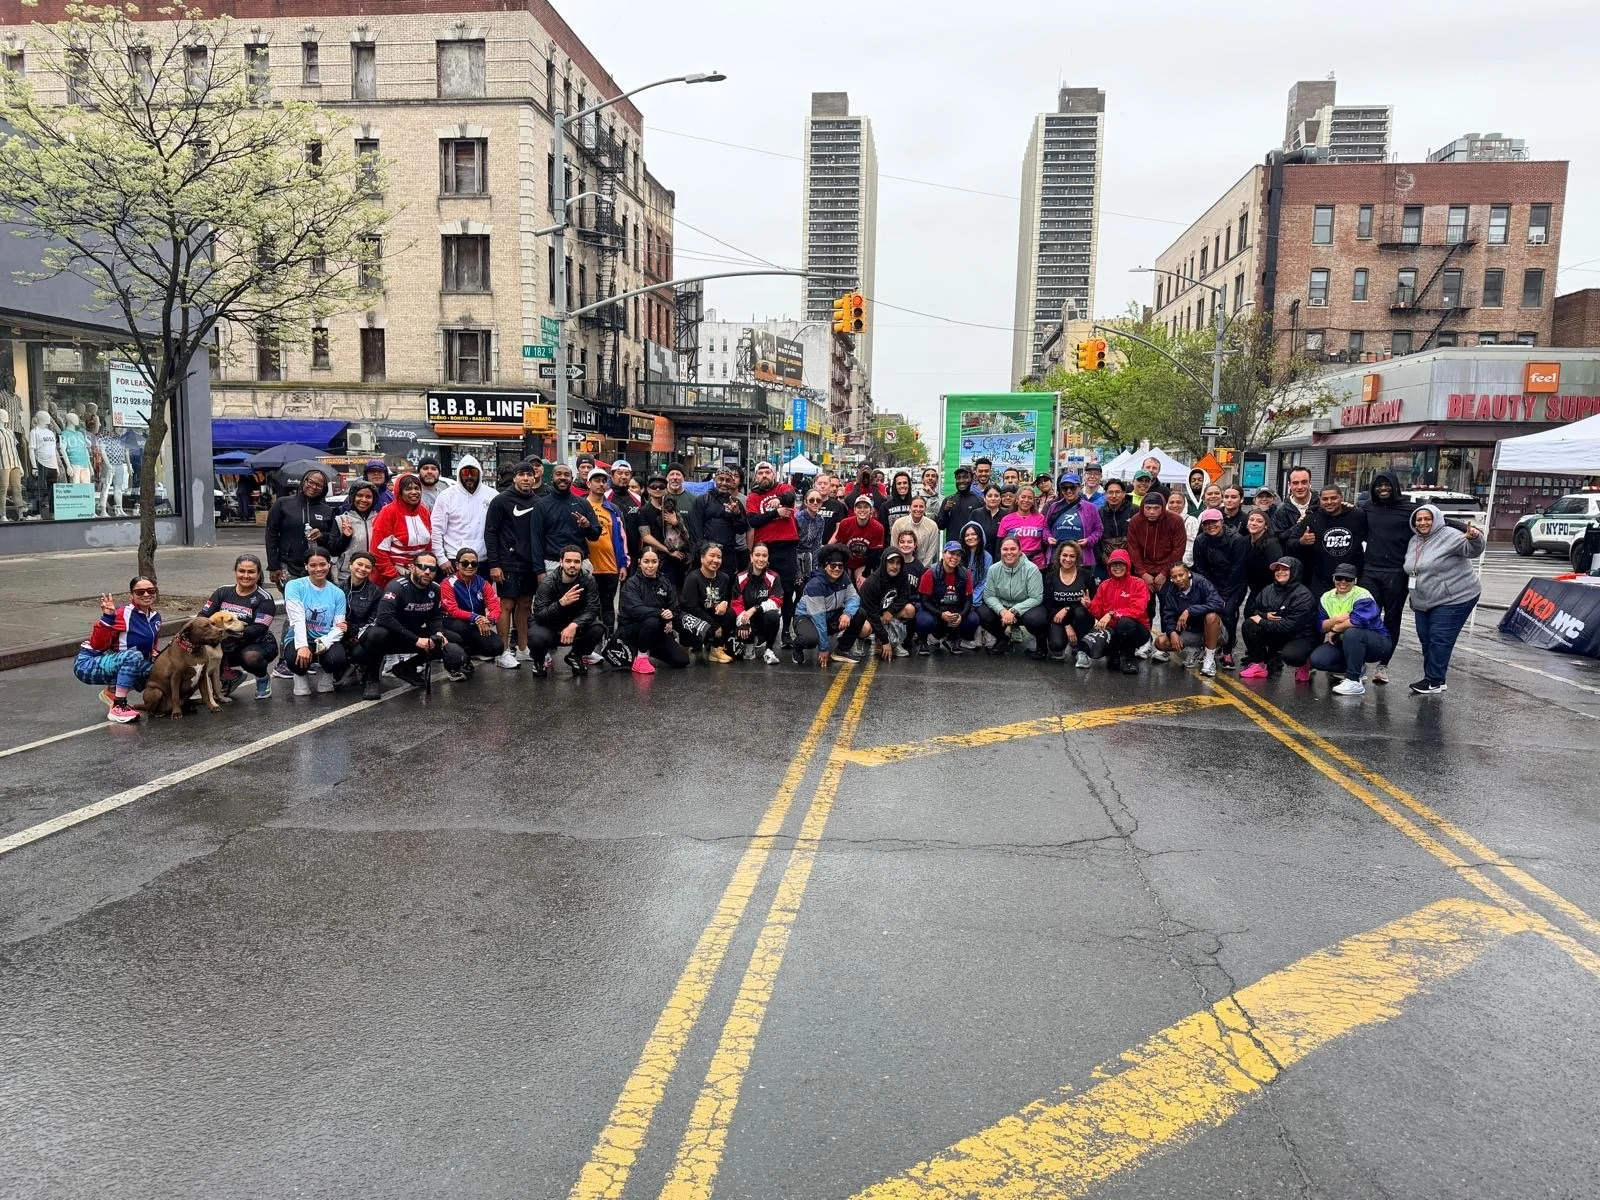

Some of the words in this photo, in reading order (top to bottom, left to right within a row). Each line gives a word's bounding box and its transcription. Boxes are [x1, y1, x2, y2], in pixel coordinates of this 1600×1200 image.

[524, 347, 531, 356] W
[534, 347, 546, 357] 182
[116, 377, 130, 386] FOR
[130, 379, 148, 388] LEAS
[1530, 372, 1557, 383] feel
[112, 396, 129, 406] (212)
[130, 397, 153, 407] 928-505
[429, 398, 482, 416] B.B.B.
[1447, 394, 1537, 421] BEAUTY
[573, 410, 596, 426] LINEN
[1341, 404, 1368, 427] BEAUTY
[1369, 399, 1403, 424] SUPPLY
[1014, 527, 1038, 537] Run
[1546, 523, 1569, 535] NYPD
[1520, 587, 1557, 621] DYCD
[1550, 609, 1585, 639] NYC
